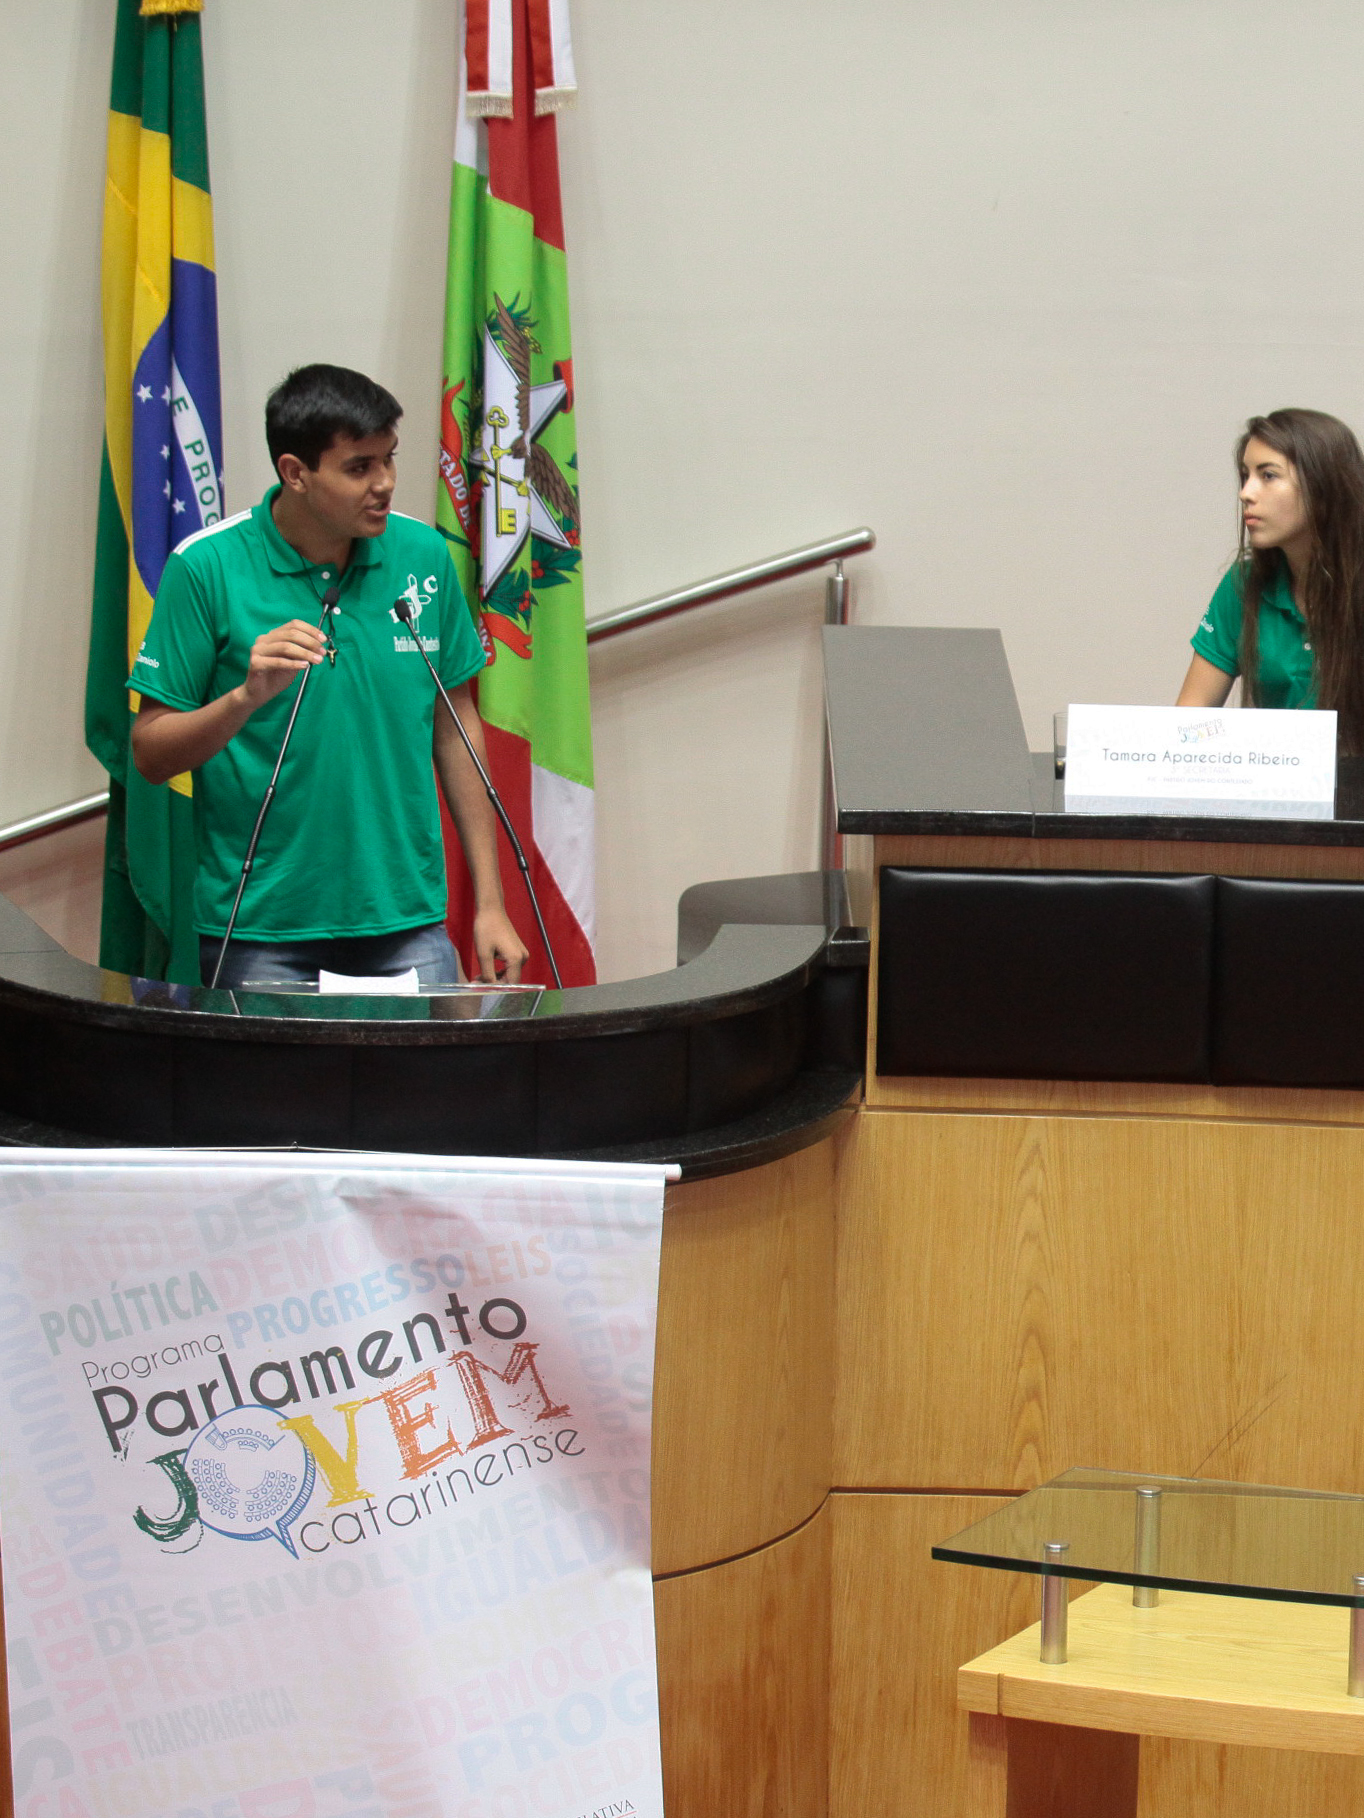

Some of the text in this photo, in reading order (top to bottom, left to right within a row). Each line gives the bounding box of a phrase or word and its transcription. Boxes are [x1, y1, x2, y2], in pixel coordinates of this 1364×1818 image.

[1103, 749, 1300, 766] Tamara Aparecida Ribeiro
[40, 1270, 219, 1356] POLÍTICA
[226, 1254, 466, 1350] PROGRESSO
[465, 1235, 551, 1288] LEIS
[82, 1333, 225, 1388] Programa
[92, 1291, 528, 1454] Parlamento
[300, 1427, 586, 1556] catarinense
[93, 1468, 651, 1658] DESENVOLVIMENTO
[16, 1562, 133, 1776] DEBATE
[126, 1684, 299, 1761] TRANSPARÊNCIA
